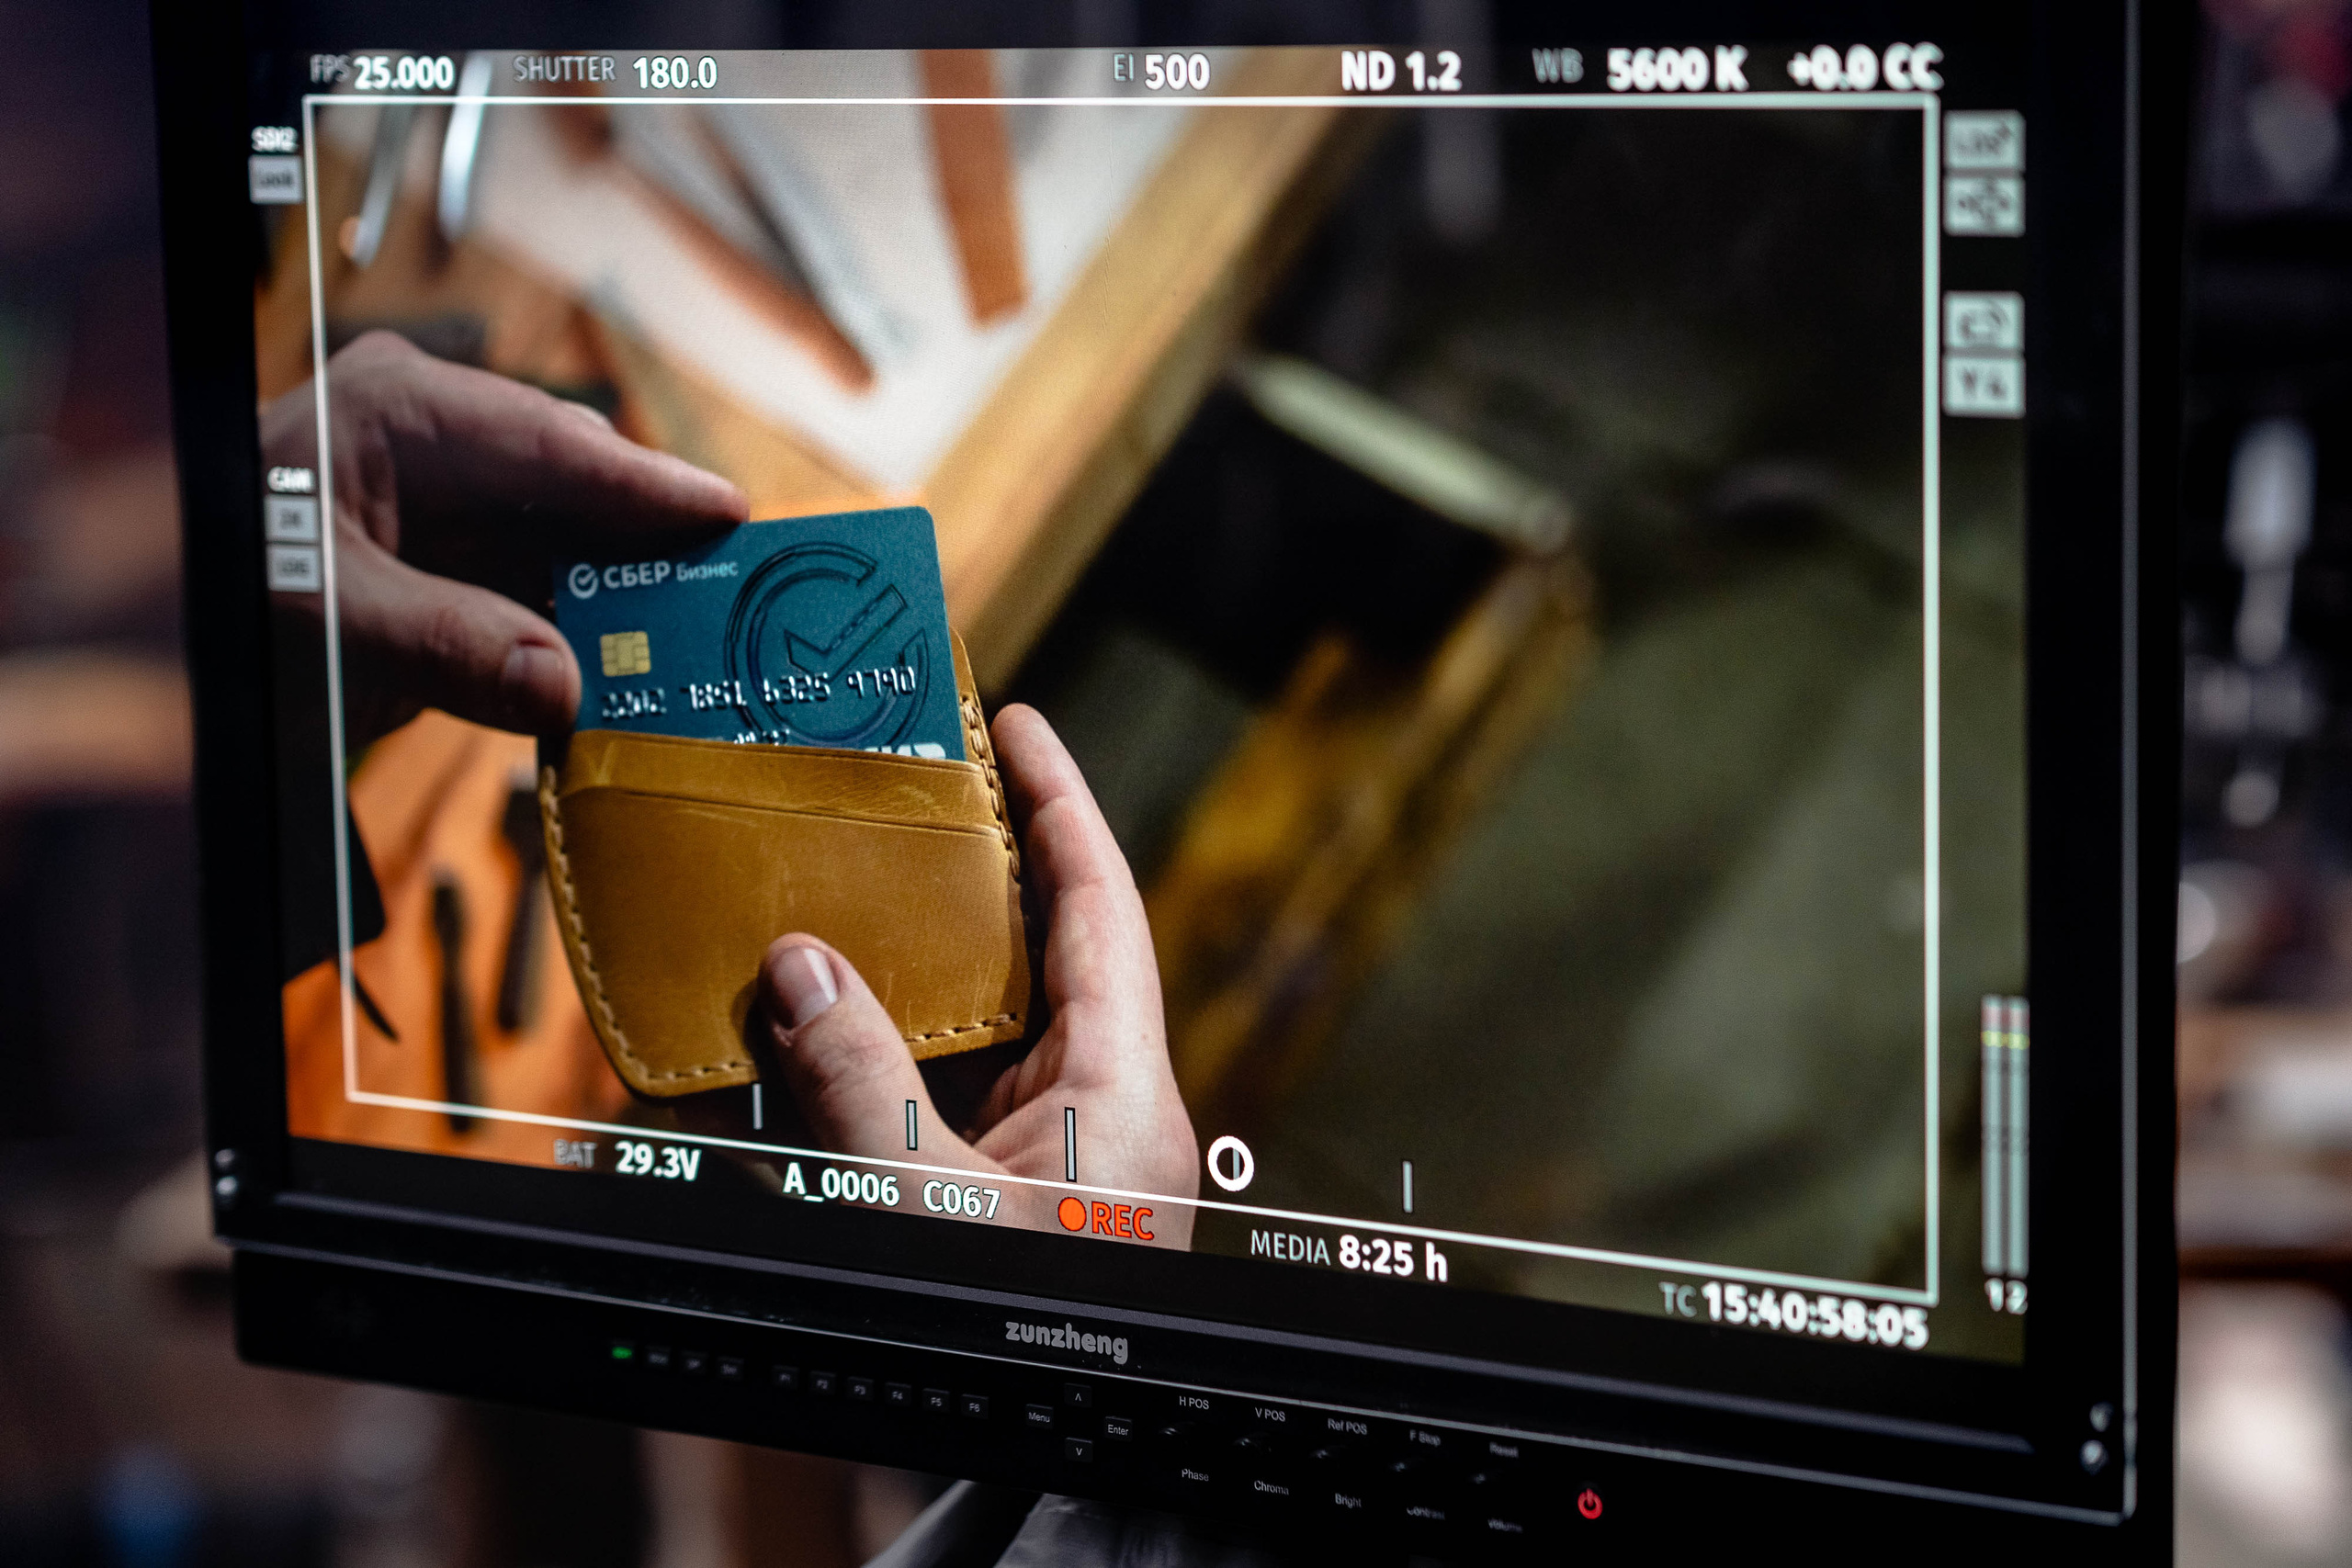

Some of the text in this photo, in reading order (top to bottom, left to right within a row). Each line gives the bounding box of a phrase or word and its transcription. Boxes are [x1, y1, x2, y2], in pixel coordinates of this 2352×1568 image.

[310, 54, 455, 90] FPS 25.000
[513, 55, 718, 89] SHUTTER 180.0
[1114, 53, 1210, 90] EI 500
[1340, 51, 1462, 92] ND 1.2
[1532, 44, 1749, 92] WB 5600 K
[1787, 41, 1945, 92] +0.0 CC
[603, 560, 672, 589] СБЕР
[554, 1138, 702, 1182] BAT 29.3V
[783, 1162, 1001, 1220] A_0006 C067
[1091, 1201, 1155, 1241] REC
[1250, 1229, 1449, 1283] MEDIA 8:25 h
[1659, 1280, 1929, 1350] TC 15:40:58:05
[1005, 1321, 1128, 1365] zunzheng
[891, 1390, 903, 1401] F4
[930, 1396, 943, 1407] F5
[968, 1402, 980, 1413] F6
[1179, 1395, 1210, 1410] H POS
[1028, 1411, 1051, 1423] Menu
[1255, 1406, 1286, 1422] V POS
[1328, 1418, 1367, 1436] Ref POS
[1107, 1424, 1129, 1436] Enter
[1182, 1468, 1210, 1482] Phase
[1253, 1480, 1290, 1495] Chroma
[1335, 1493, 1363, 1509] Bright
